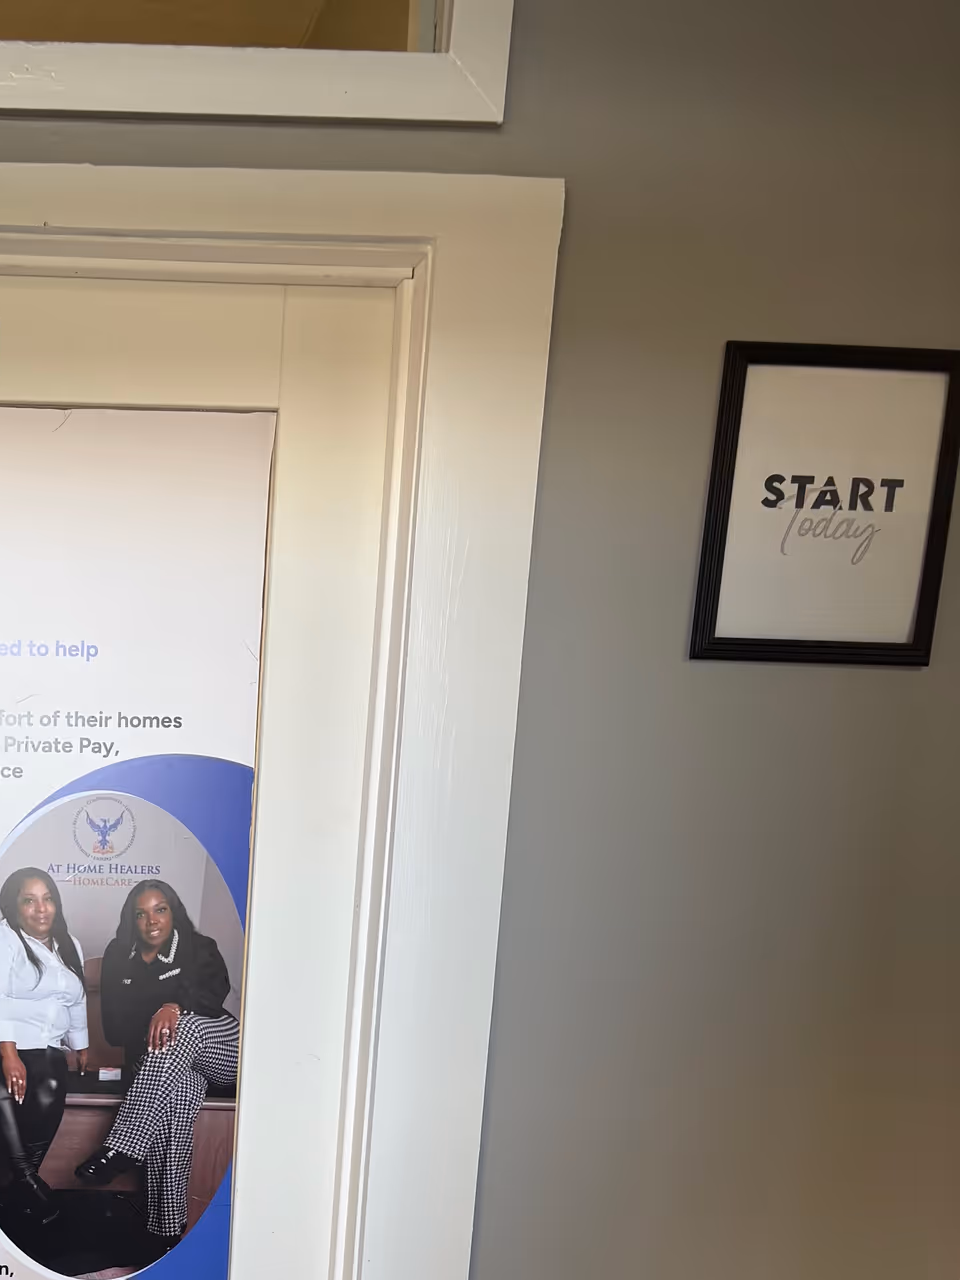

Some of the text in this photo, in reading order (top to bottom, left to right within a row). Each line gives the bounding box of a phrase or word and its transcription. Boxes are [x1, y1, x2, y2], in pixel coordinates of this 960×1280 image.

[760, 473, 905, 513] START
[775, 485, 882, 566] Today
[109, 863, 161, 876] HEALERS
